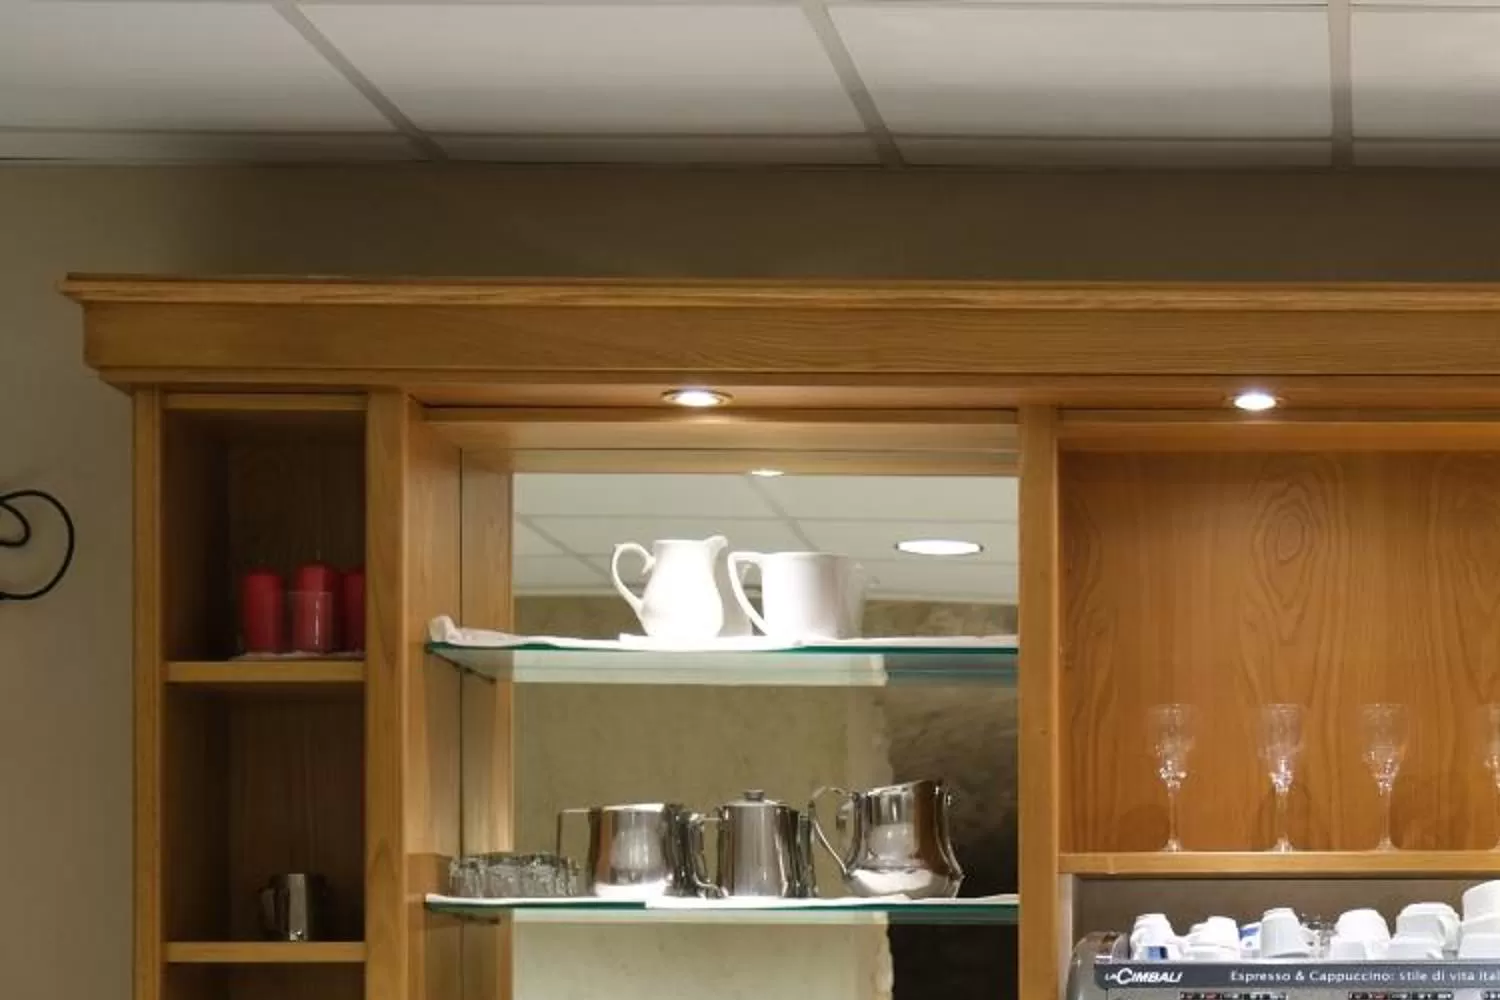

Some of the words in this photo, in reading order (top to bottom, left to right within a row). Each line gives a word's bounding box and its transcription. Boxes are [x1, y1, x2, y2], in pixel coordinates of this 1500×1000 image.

[1117, 968, 1184, 985] CIMBALI
[1230, 969, 1291, 984] Espresso
[1295, 970, 1305, 982] &
[1309, 970, 1395, 984] Cappuccino:
[1399, 969, 1428, 982] stile
[1432, 969, 1446, 982] di
[1449, 969, 1475, 982] vita
